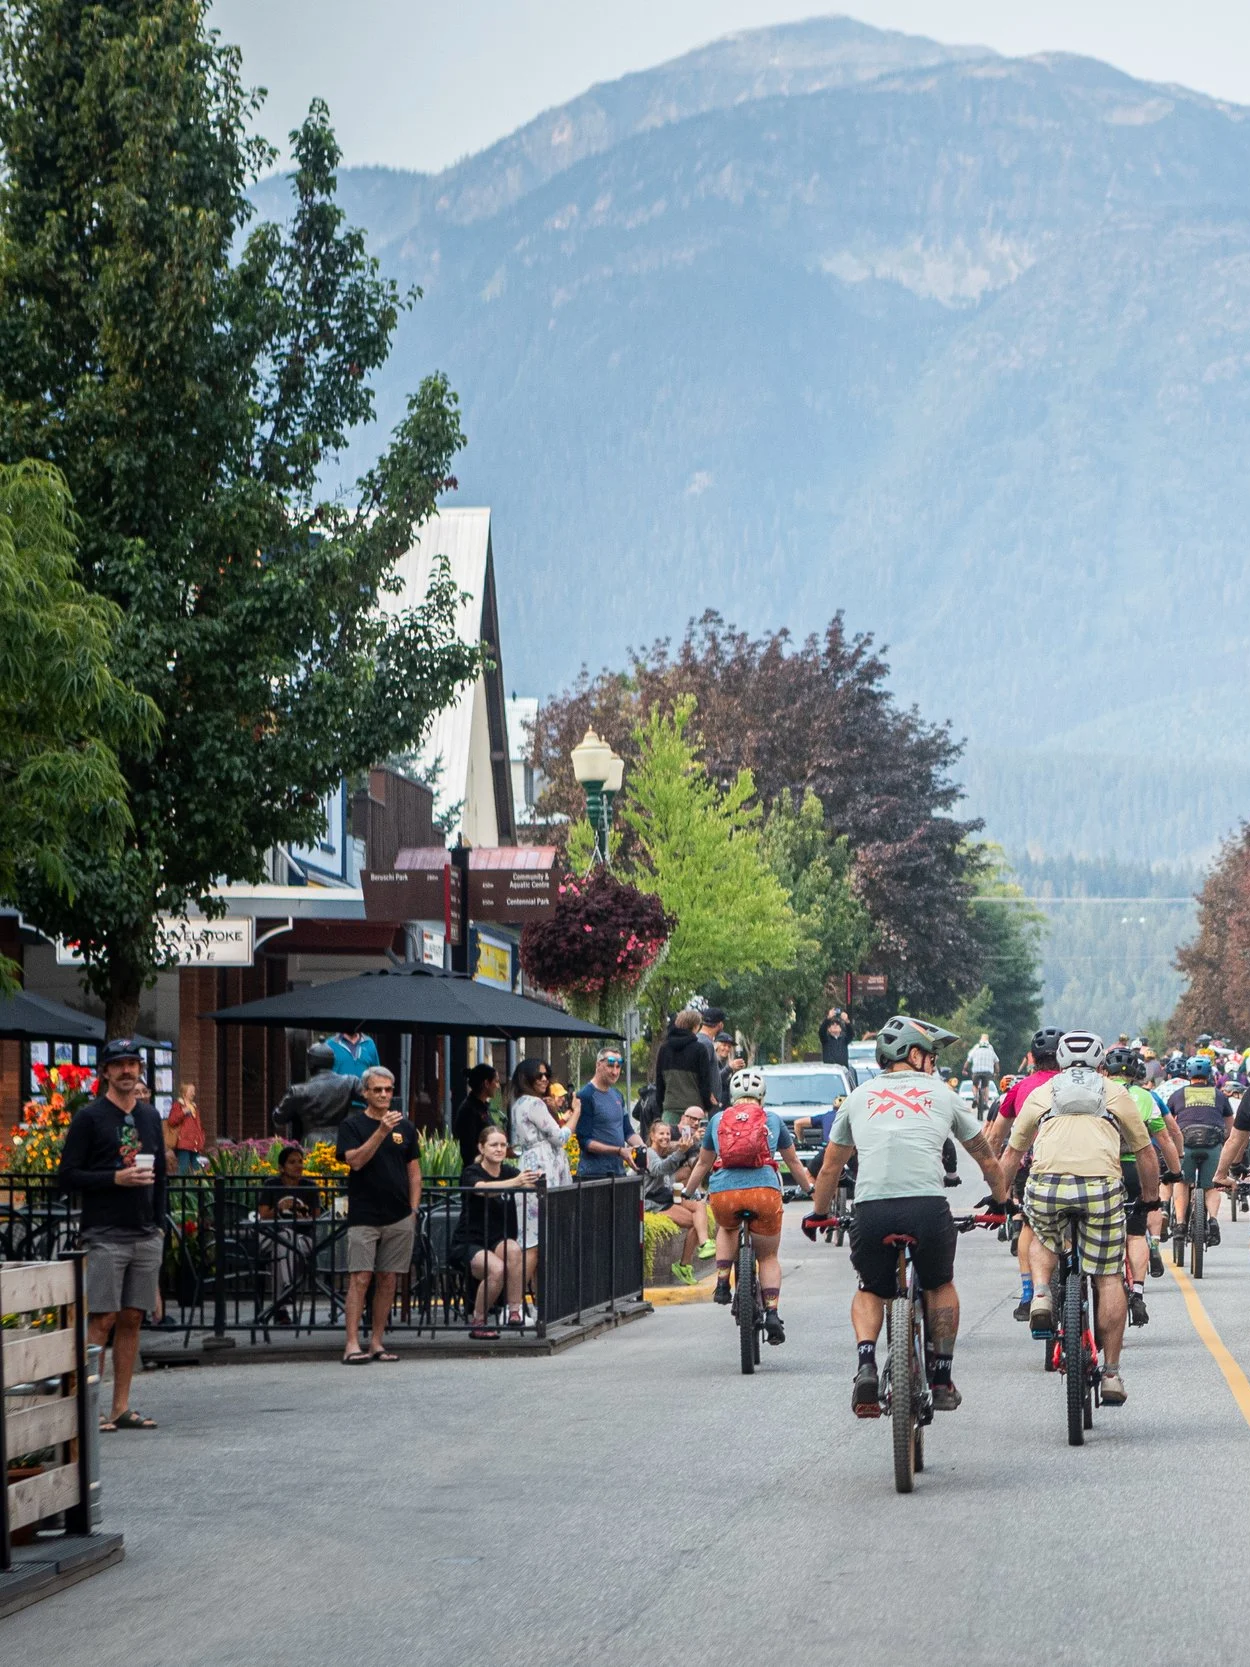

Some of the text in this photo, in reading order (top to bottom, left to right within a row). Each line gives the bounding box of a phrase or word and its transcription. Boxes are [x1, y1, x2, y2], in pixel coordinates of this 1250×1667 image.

[371, 873, 408, 881] Beruschi Park
[513, 872, 544, 881] Community
[510, 881, 530, 889] Aquatic
[158, 931, 243, 942] EVELSTOKE
